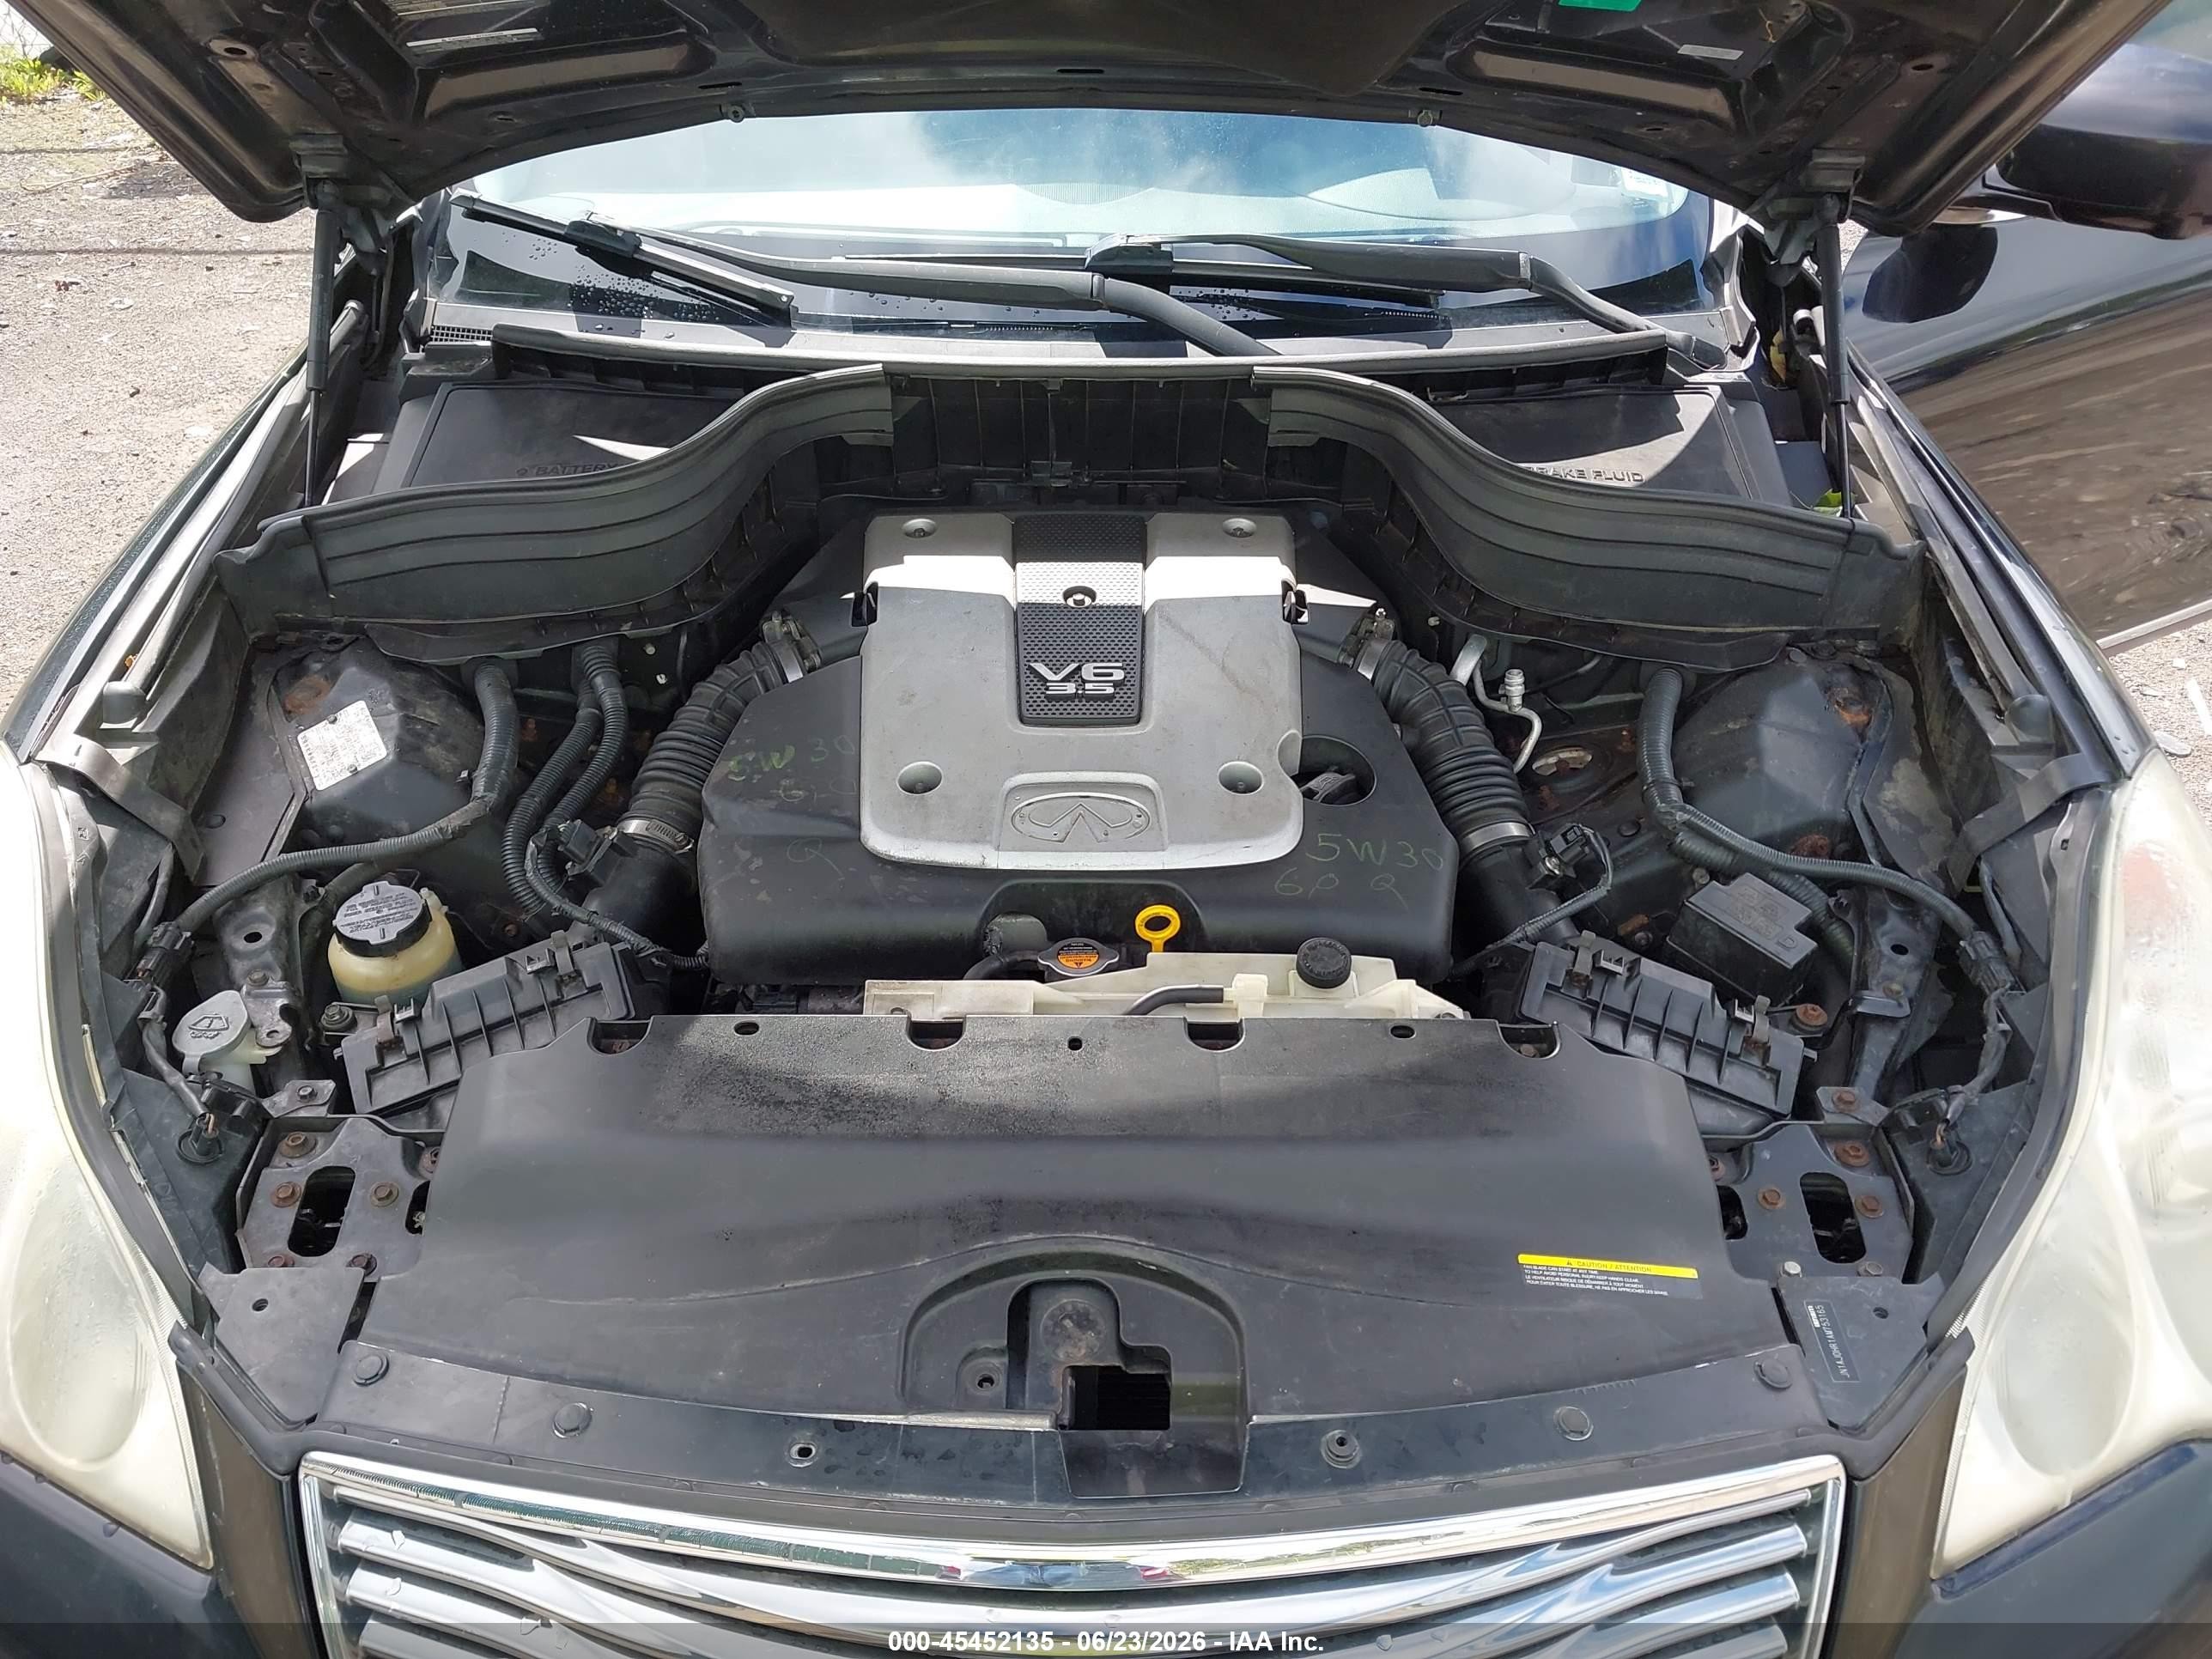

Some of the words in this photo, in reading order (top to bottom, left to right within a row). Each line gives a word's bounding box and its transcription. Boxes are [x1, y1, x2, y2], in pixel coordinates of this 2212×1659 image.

[1592, 469, 1644, 482] FLUID
[1030, 662, 1125, 681] V6
[1046, 682, 1115, 695] 3.5
[1577, 1261, 1607, 1269] CAUTION
[1614, 1263, 1651, 1273] ATTENTION
